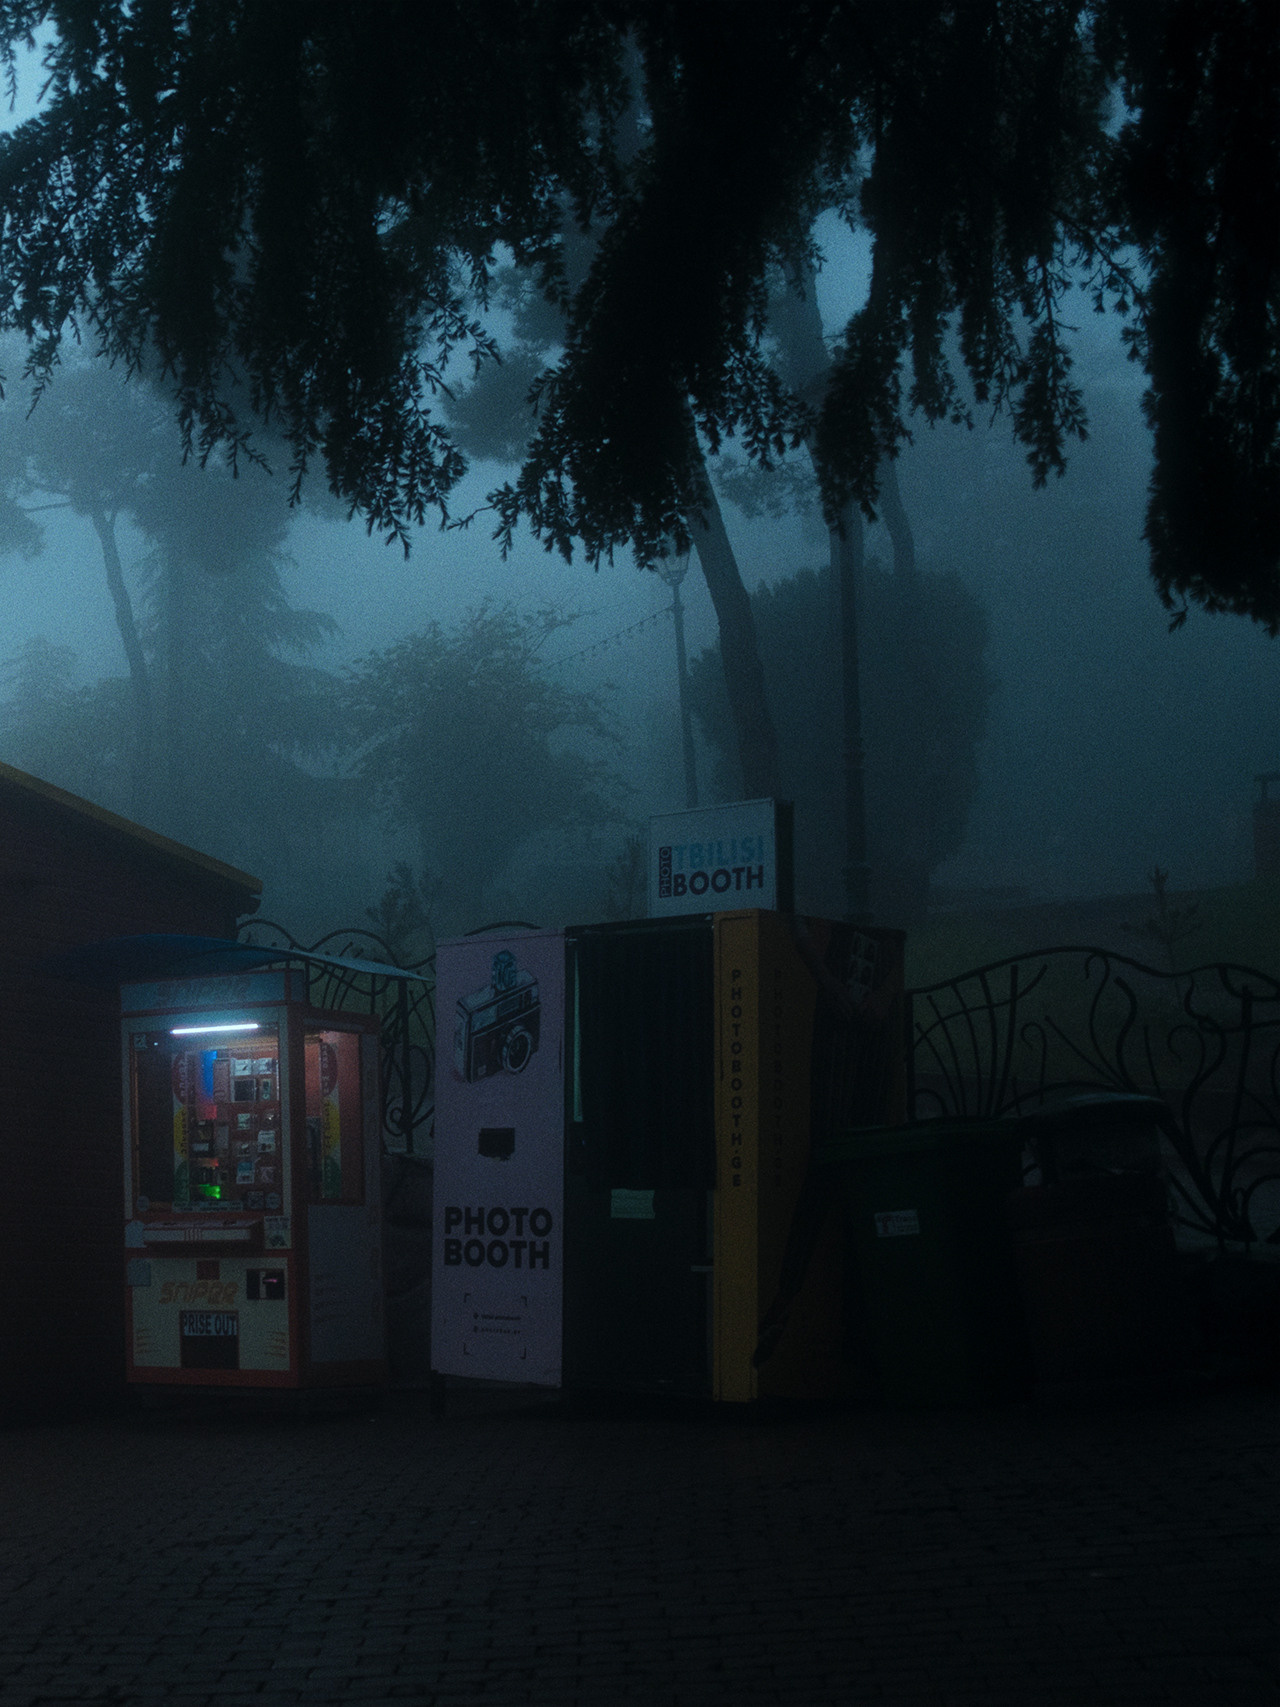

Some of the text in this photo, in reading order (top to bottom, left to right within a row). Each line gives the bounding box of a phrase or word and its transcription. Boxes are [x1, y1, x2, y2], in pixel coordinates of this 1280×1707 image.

[674, 836, 764, 868] TBILISI
[659, 847, 672, 897] PHOTO
[673, 866, 763, 896] BOOTH
[444, 1206, 553, 1238] PHOTO
[443, 1239, 550, 1269] BOOTH
[214, 1315, 236, 1336] OUT
